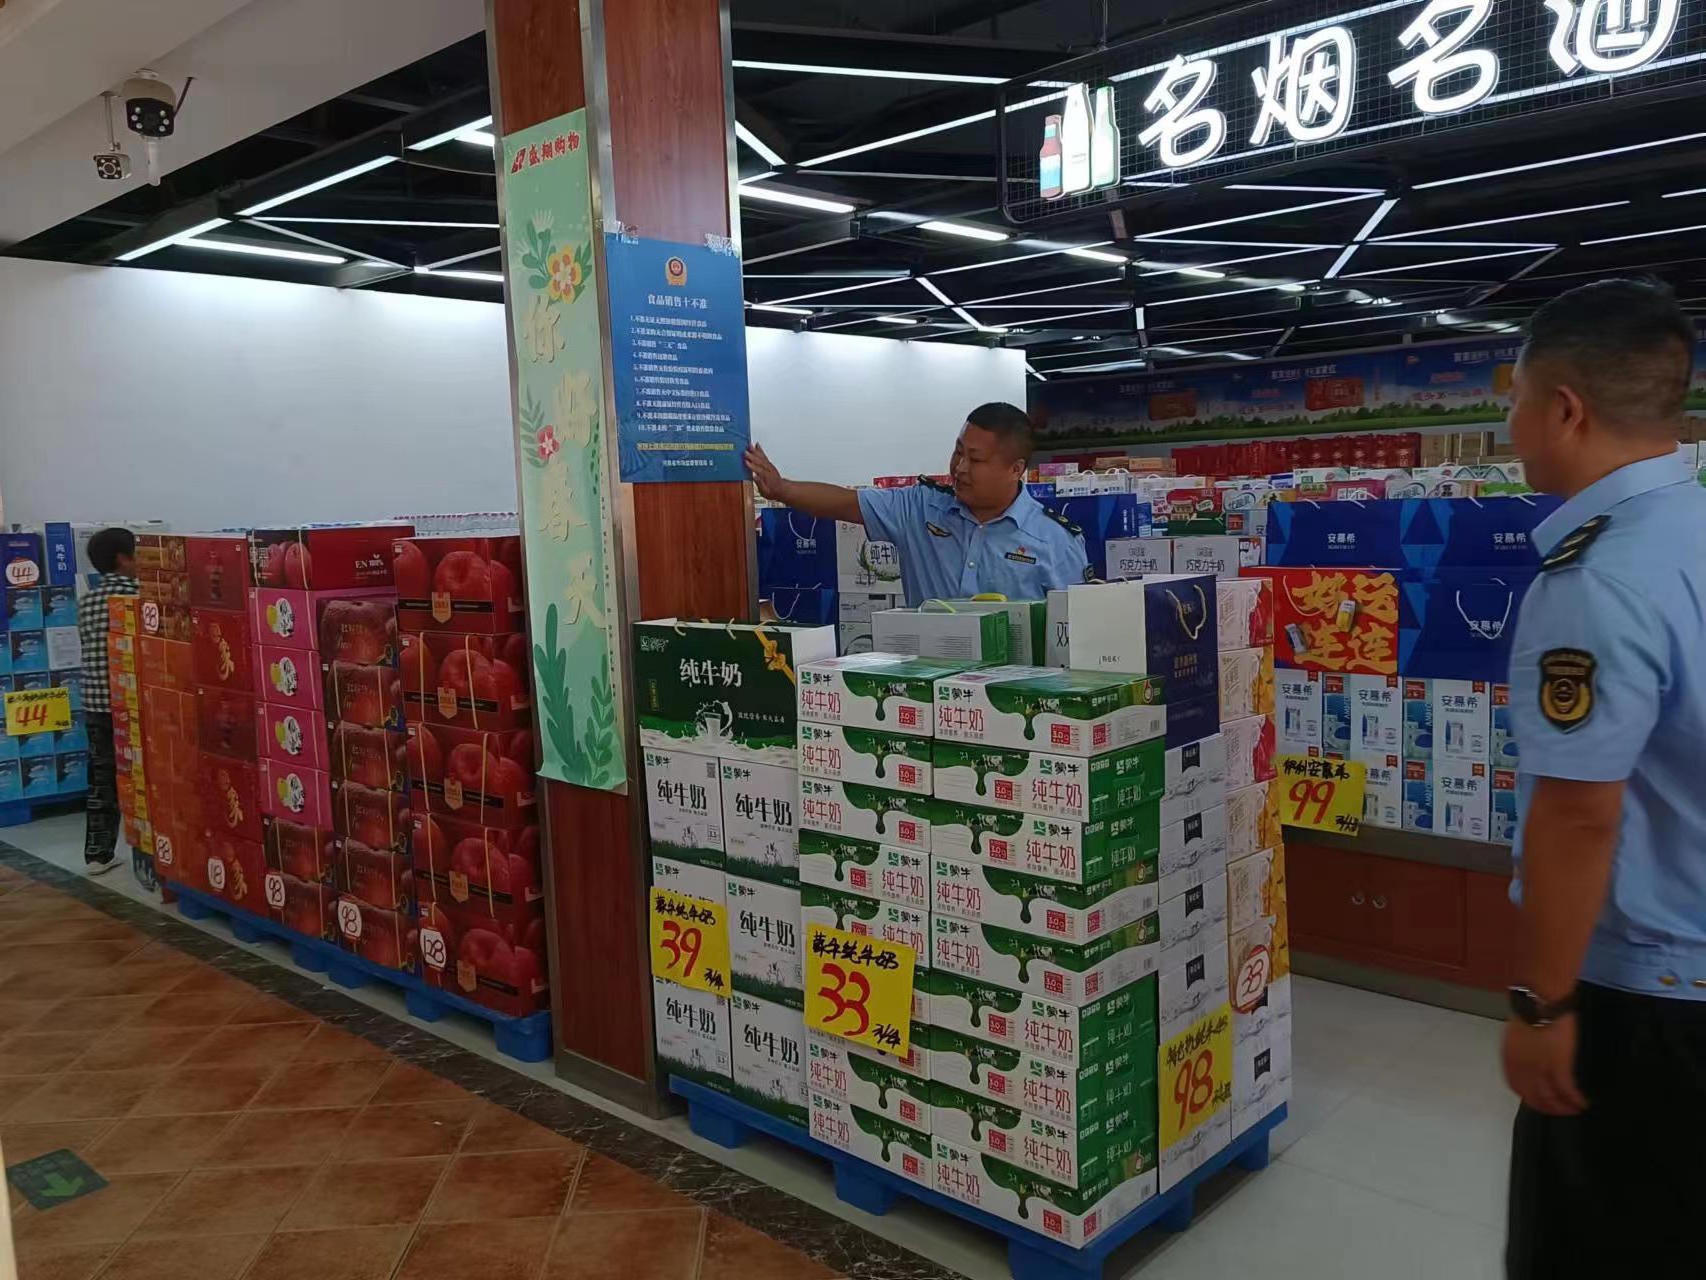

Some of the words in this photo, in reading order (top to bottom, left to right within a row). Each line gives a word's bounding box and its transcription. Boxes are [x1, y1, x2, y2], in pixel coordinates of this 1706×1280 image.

[647, 293, 708, 309] 食品销售十不准
[1327, 533, 1357, 544] 安慕希
[1493, 532, 1527, 544] 安慕希
[11, 566, 32, 578] 44
[1119, 558, 1158, 571] 巧克力牛奶
[1186, 559, 1225, 572] 巧克力牛奶
[679, 658, 743, 688] 纯牛奶
[813, 673, 833, 687] 蒙牛
[802, 689, 841, 714] 纯牛奶
[952, 688, 975, 703] 蒙牛
[1282, 683, 1313, 696] 安慕希
[1359, 689, 1392, 703] 安慕希
[1441, 695, 1478, 709] 安慕希
[15, 703, 49, 727] 44
[939, 706, 984, 732] 纯牛奶
[814, 728, 833, 742] 蒙牛
[803, 744, 841, 770] 纯牛奶
[733, 767, 752, 781] 蒙牛
[1055, 762, 1080, 777] 蒙牛
[1365, 768, 1391, 781] 慕希
[657, 779, 707, 810] 纯牛奶
[814, 783, 833, 796] 蒙牛
[1032, 779, 1083, 809] 纯牛奶
[1441, 777, 1478, 792] 安慕希
[735, 793, 792, 827] 纯牛奶
[803, 798, 842, 825] 纯牛奶
[1289, 780, 1335, 825] 99
[1048, 823, 1073, 840] 蒙牛
[901, 855, 922, 871] 蒙牛
[1027, 840, 1076, 870] 纯牛奶
[882, 869, 925, 898] 纯牛奶
[950, 864, 971, 880] 蒙牛
[268, 876, 283, 904] 98
[738, 885, 757, 900] 蒙牛
[937, 880, 981, 910] 纯牛奶
[341, 904, 358, 934] 98
[655, 892, 717, 926] 蒙牛纯牛奶
[901, 911, 921, 927] 蒙牛
[740, 910, 795, 948] 纯牛奶
[882, 924, 924, 954] 纯牛奶
[950, 921, 971, 937] 蒙牛
[423, 935, 445, 964] 128
[660, 920, 702, 978] 39
[812, 930, 899, 970] 蒙牛纯牛奶
[936, 938, 981, 969] 纯牛奶
[743, 999, 761, 1015] 蒙牛
[817, 963, 871, 1036] 33
[666, 998, 716, 1035] 纯牛奶
[1046, 1006, 1070, 1023] 蒙牛
[744, 1024, 799, 1066] 纯牛奶
[1025, 1019, 1073, 1053] 纯牛奶
[821, 1045, 838, 1063] 蒙牛
[810, 1061, 848, 1092] 纯牛奶
[1045, 1065, 1068, 1083] 蒙牛
[1023, 1078, 1071, 1114] 纯牛奶
[1174, 1049, 1213, 1132] 98
[824, 1099, 841, 1113] 蒙牛
[813, 1110, 849, 1143] 纯牛奶
[1045, 1125, 1068, 1143] 蒙牛
[950, 1150, 969, 1165] 蒙牛
[1024, 1136, 1072, 1174] 纯牛奶
[937, 1164, 980, 1198] 纯牛奶
